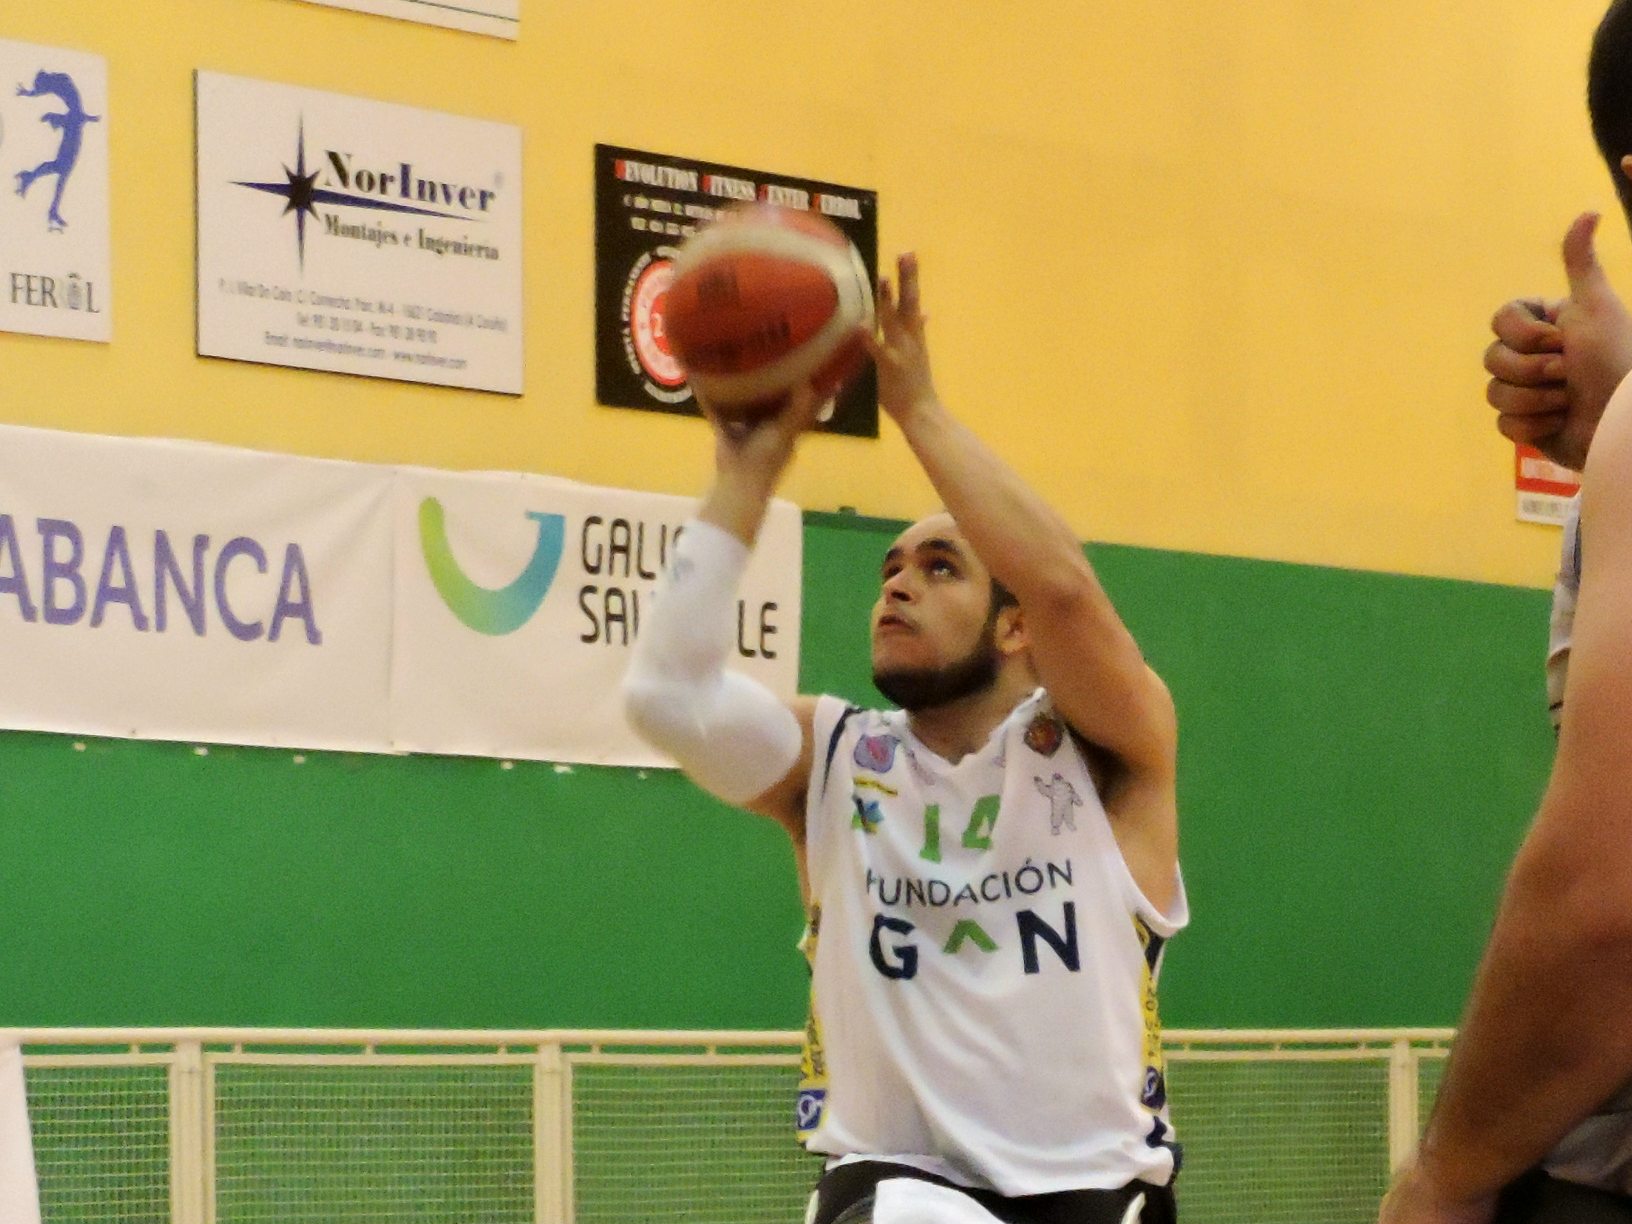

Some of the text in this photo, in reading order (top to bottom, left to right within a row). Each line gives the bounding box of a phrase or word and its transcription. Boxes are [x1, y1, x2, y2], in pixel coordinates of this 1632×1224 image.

[324, 149, 496, 212] NorInver
[323, 213, 400, 250] Montajes
[402, 232, 413, 248] e
[0, 513, 323, 647] ABANCA
[581, 515, 690, 584] GALI
[580, 584, 778, 660] SALE
[919, 794, 1002, 864] 14
[866, 858, 1074, 908] FUNDACIÓN
